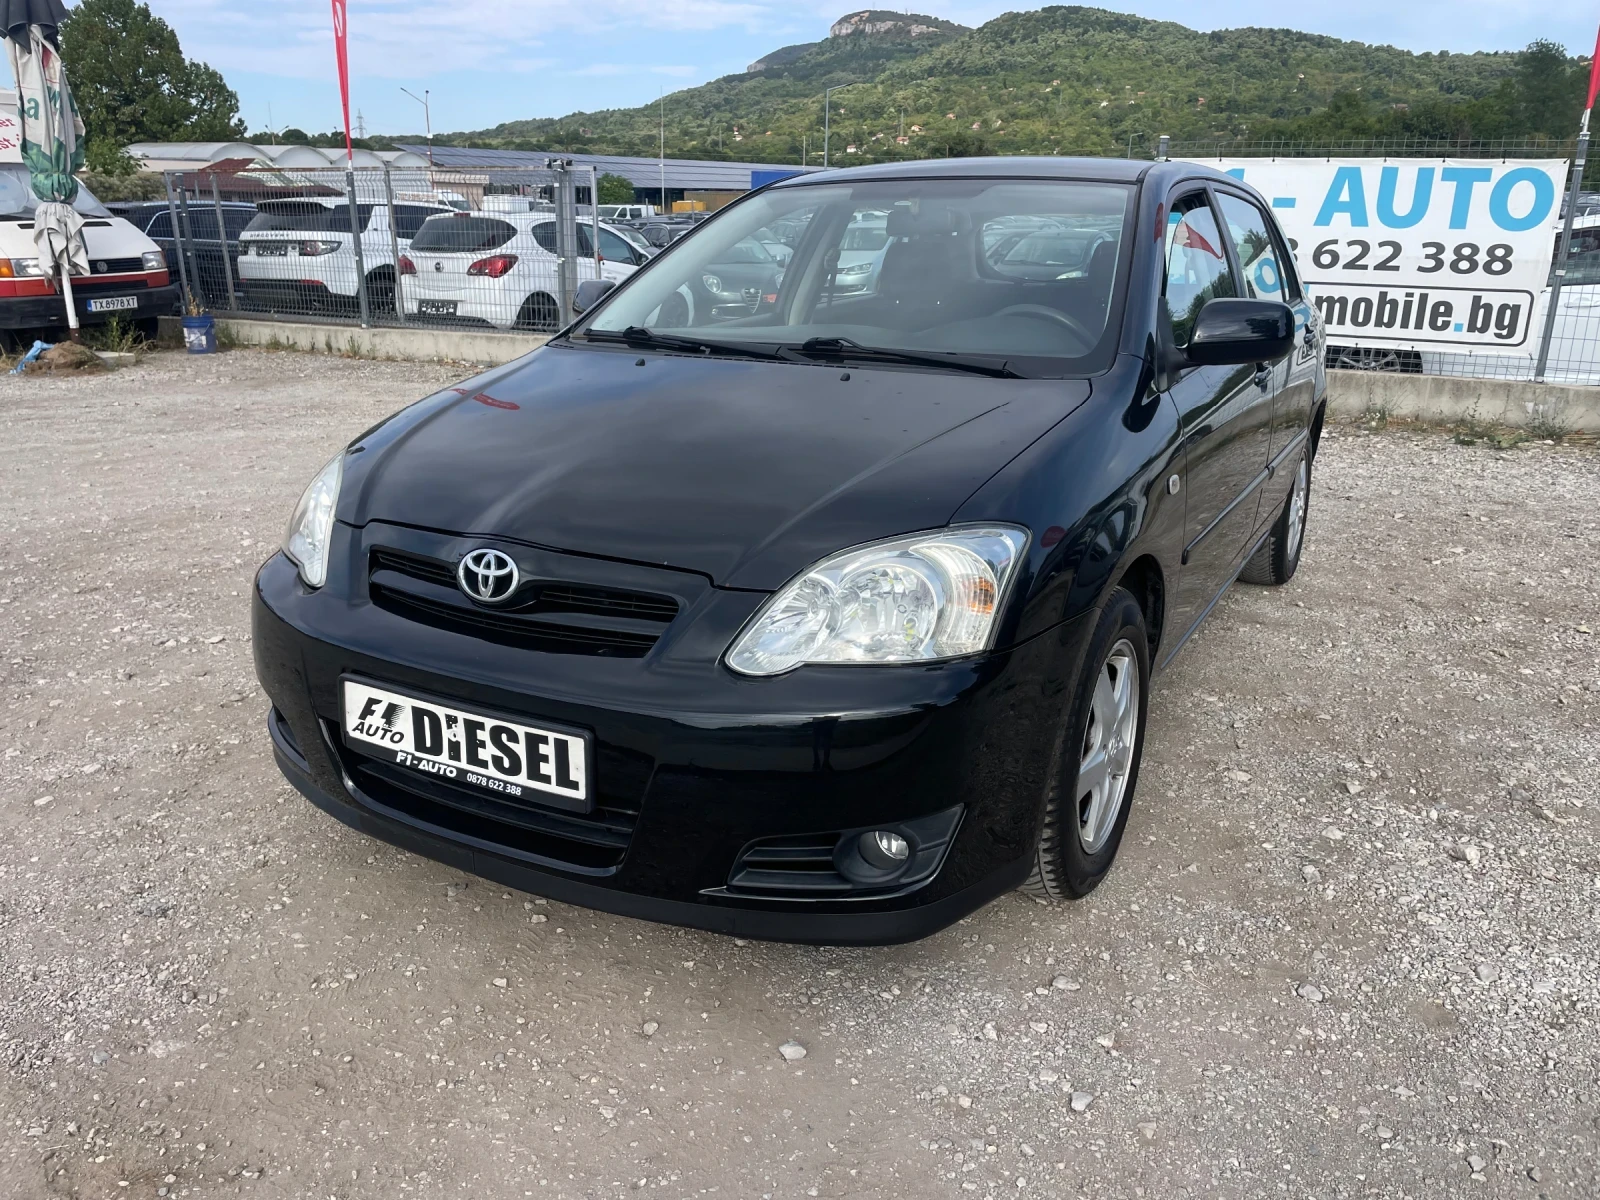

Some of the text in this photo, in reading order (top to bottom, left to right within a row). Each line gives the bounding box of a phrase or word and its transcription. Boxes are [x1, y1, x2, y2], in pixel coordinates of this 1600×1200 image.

[1313, 166, 1556, 232] AUTO
[1312, 239, 1404, 272] 622
[1416, 241, 1514, 276] 388
[1315, 291, 1522, 339] mobile.bg
[351, 720, 405, 744] AUTO
[410, 705, 580, 792] DIESEL
[396, 751, 457, 778] F1-AUTO
[466, 772, 522, 796] 0878 622 388
